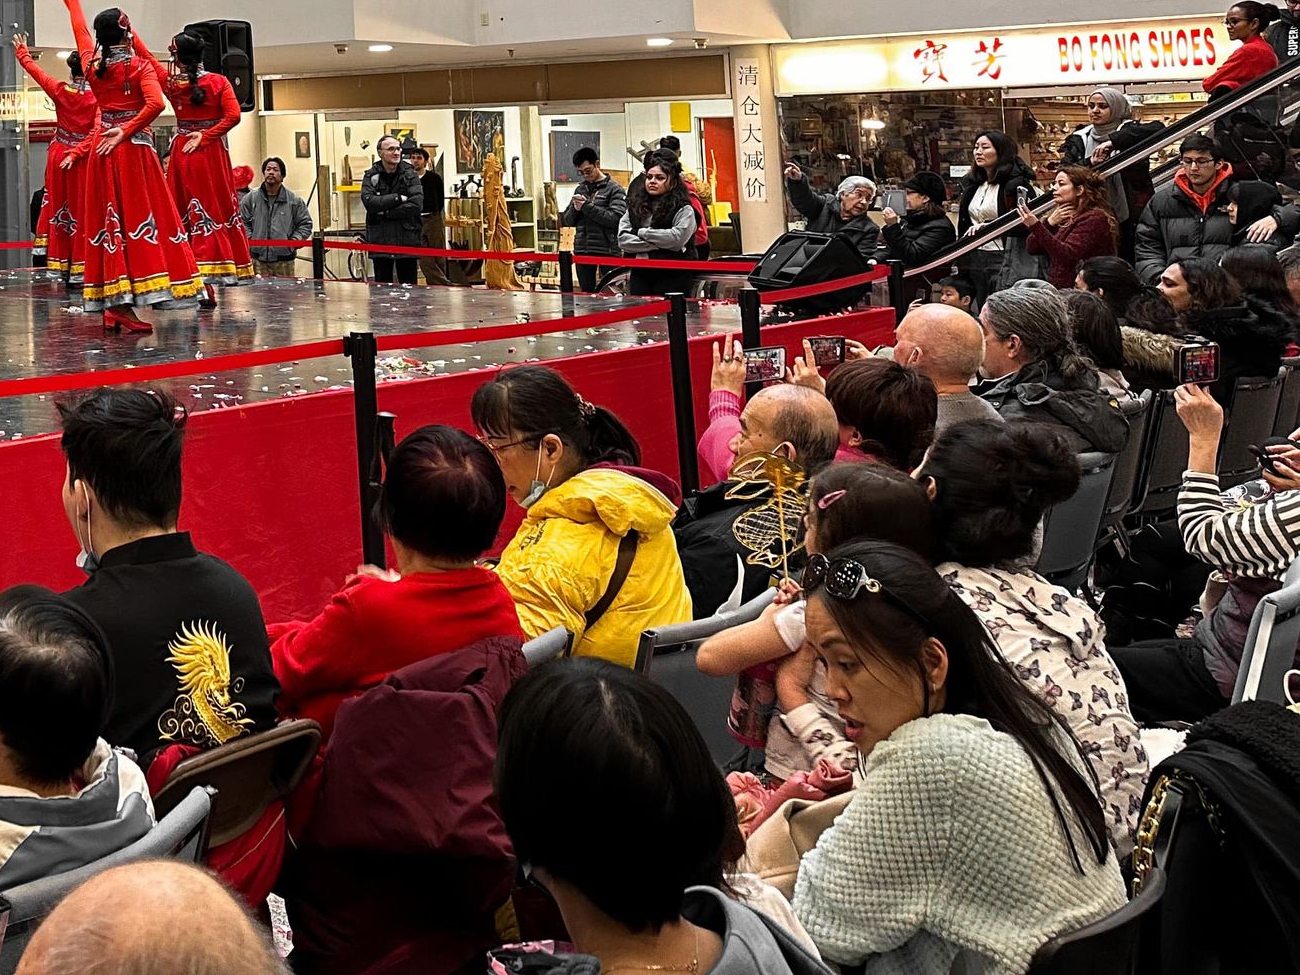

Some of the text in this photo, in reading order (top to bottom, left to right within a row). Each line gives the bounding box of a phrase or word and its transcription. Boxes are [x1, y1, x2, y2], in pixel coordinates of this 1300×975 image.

[1058, 27, 1217, 73] BO FONG SHOES
[1287, 25, 1299, 56] SUPER
